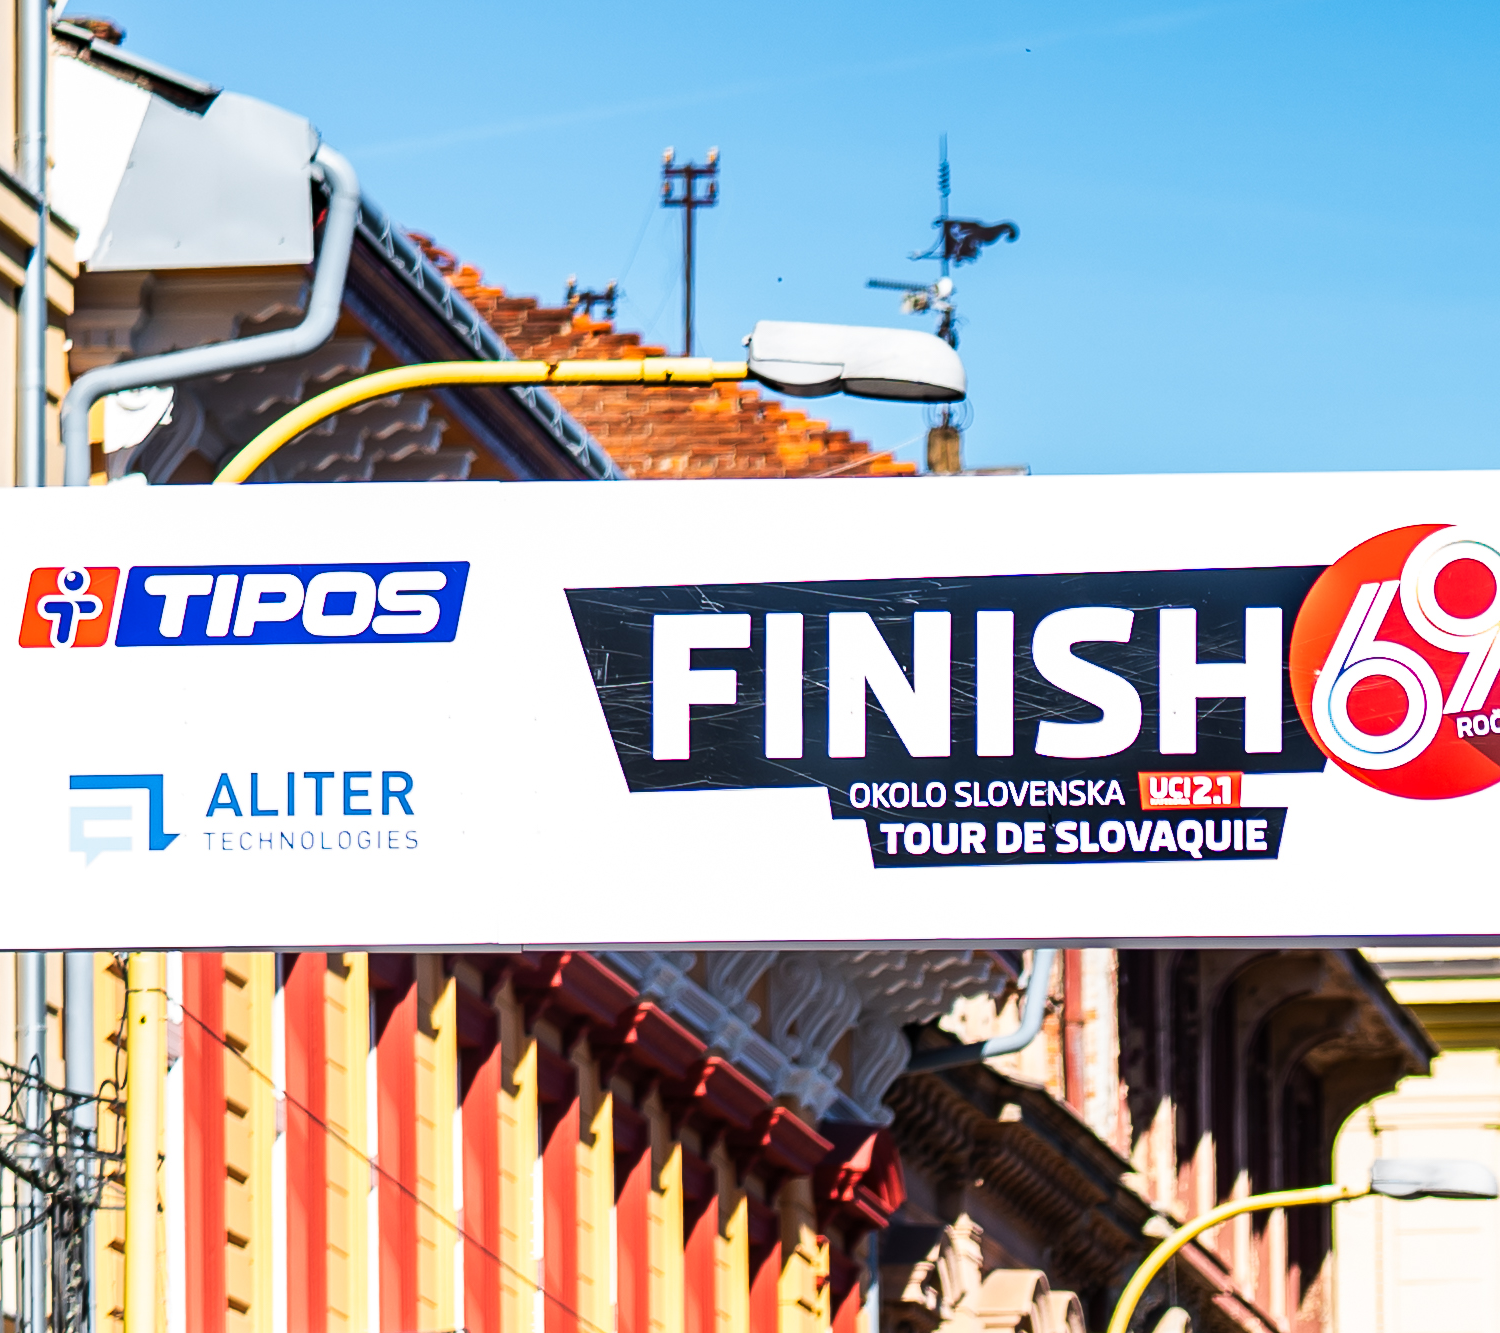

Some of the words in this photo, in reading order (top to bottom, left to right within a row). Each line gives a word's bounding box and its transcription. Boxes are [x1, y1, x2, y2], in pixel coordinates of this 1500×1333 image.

[145, 570, 448, 638] TIPOS
[653, 601, 1283, 761] FINISH
[205, 770, 415, 818] ALITER
[849, 782, 947, 809] OKOLO
[955, 779, 1125, 808] SLOVENSKA
[1150, 776, 1191, 799] UCI
[1192, 776, 1231, 805] 2.1
[203, 830, 419, 852] TECHNOLOGIES
[879, 822, 986, 855] TOUR
[996, 821, 1046, 854] DE
[1052, 819, 1268, 859] SLOVAQUIE
